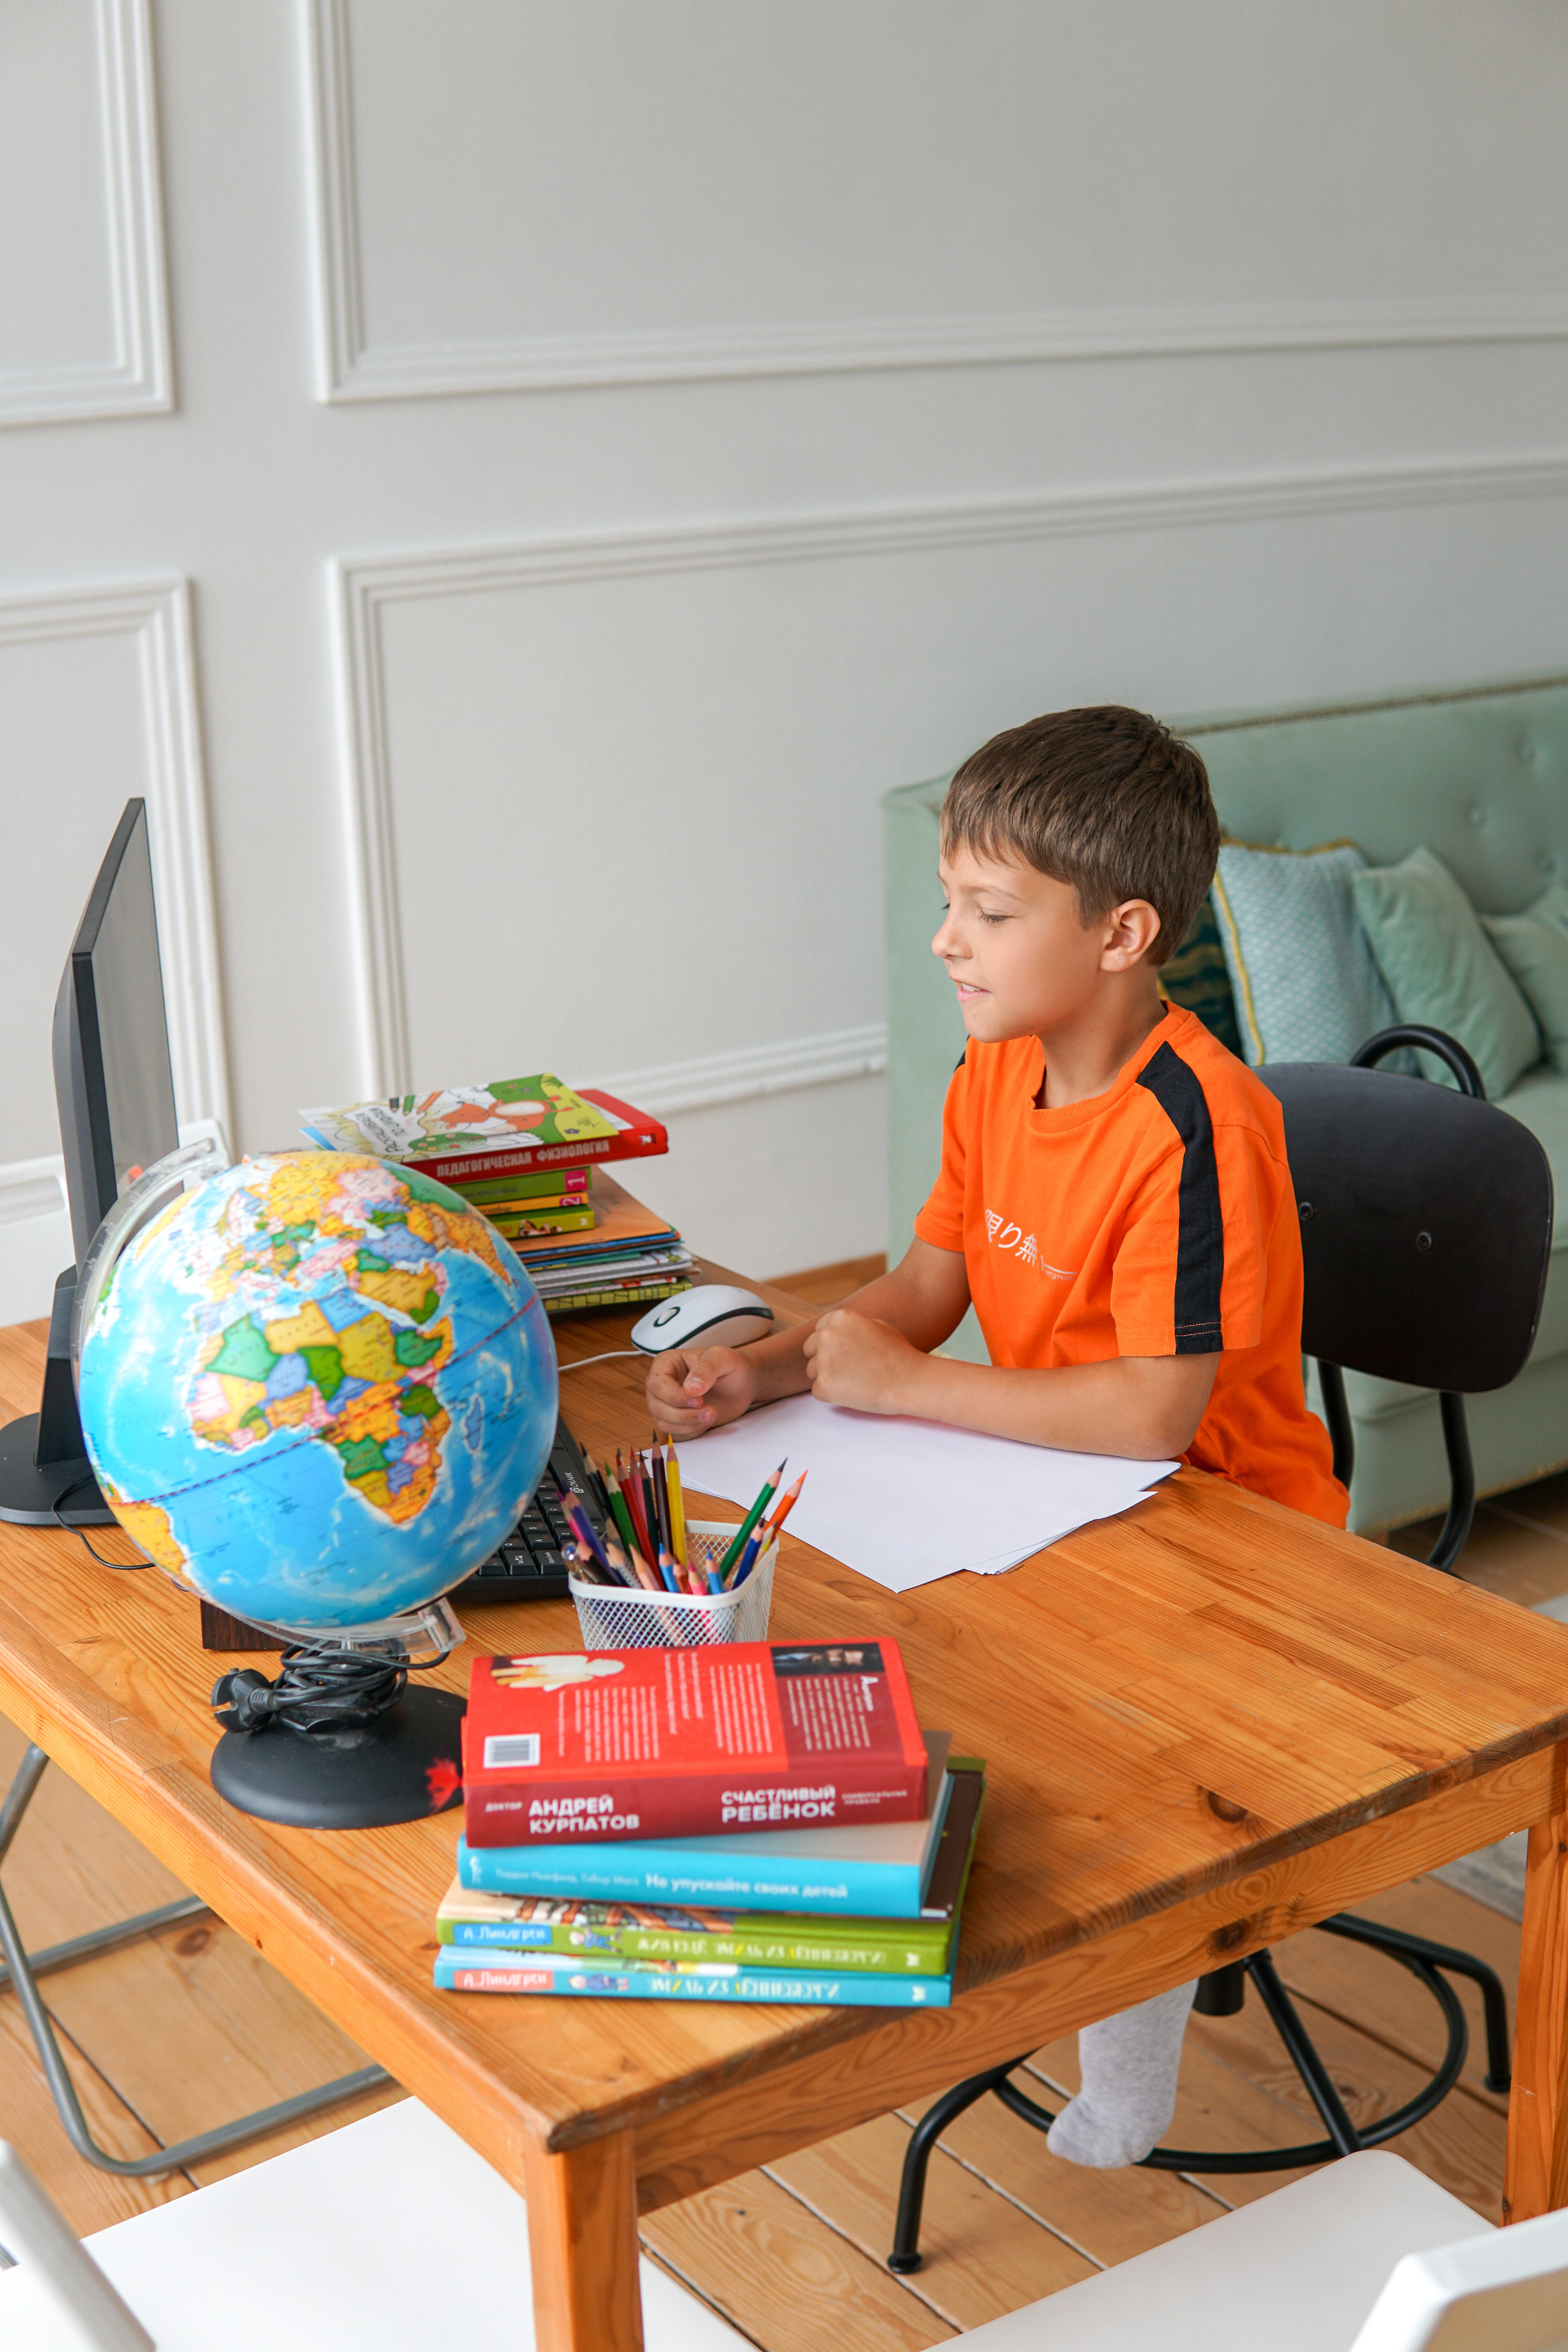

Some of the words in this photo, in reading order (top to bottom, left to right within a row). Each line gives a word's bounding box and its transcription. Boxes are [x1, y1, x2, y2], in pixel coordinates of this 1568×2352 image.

[437, 1151, 532, 1177] ПЕДАГОГИЧЕСКАЯ
[537, 1140, 610, 1162] ФИЗИОЛОГИЯ
[529, 1794, 614, 1817] АНДРЕЙ
[721, 1784, 835, 1805] СЧАСТЛИВЫЙ
[722, 1799, 835, 1823] РЕБЁНОК
[530, 1814, 640, 1834] КУРПАТОВ
[646, 1872, 668, 1889] Не
[671, 1877, 751, 1894] упускайте
[753, 1882, 799, 1895] своих
[801, 1883, 848, 1898] детей
